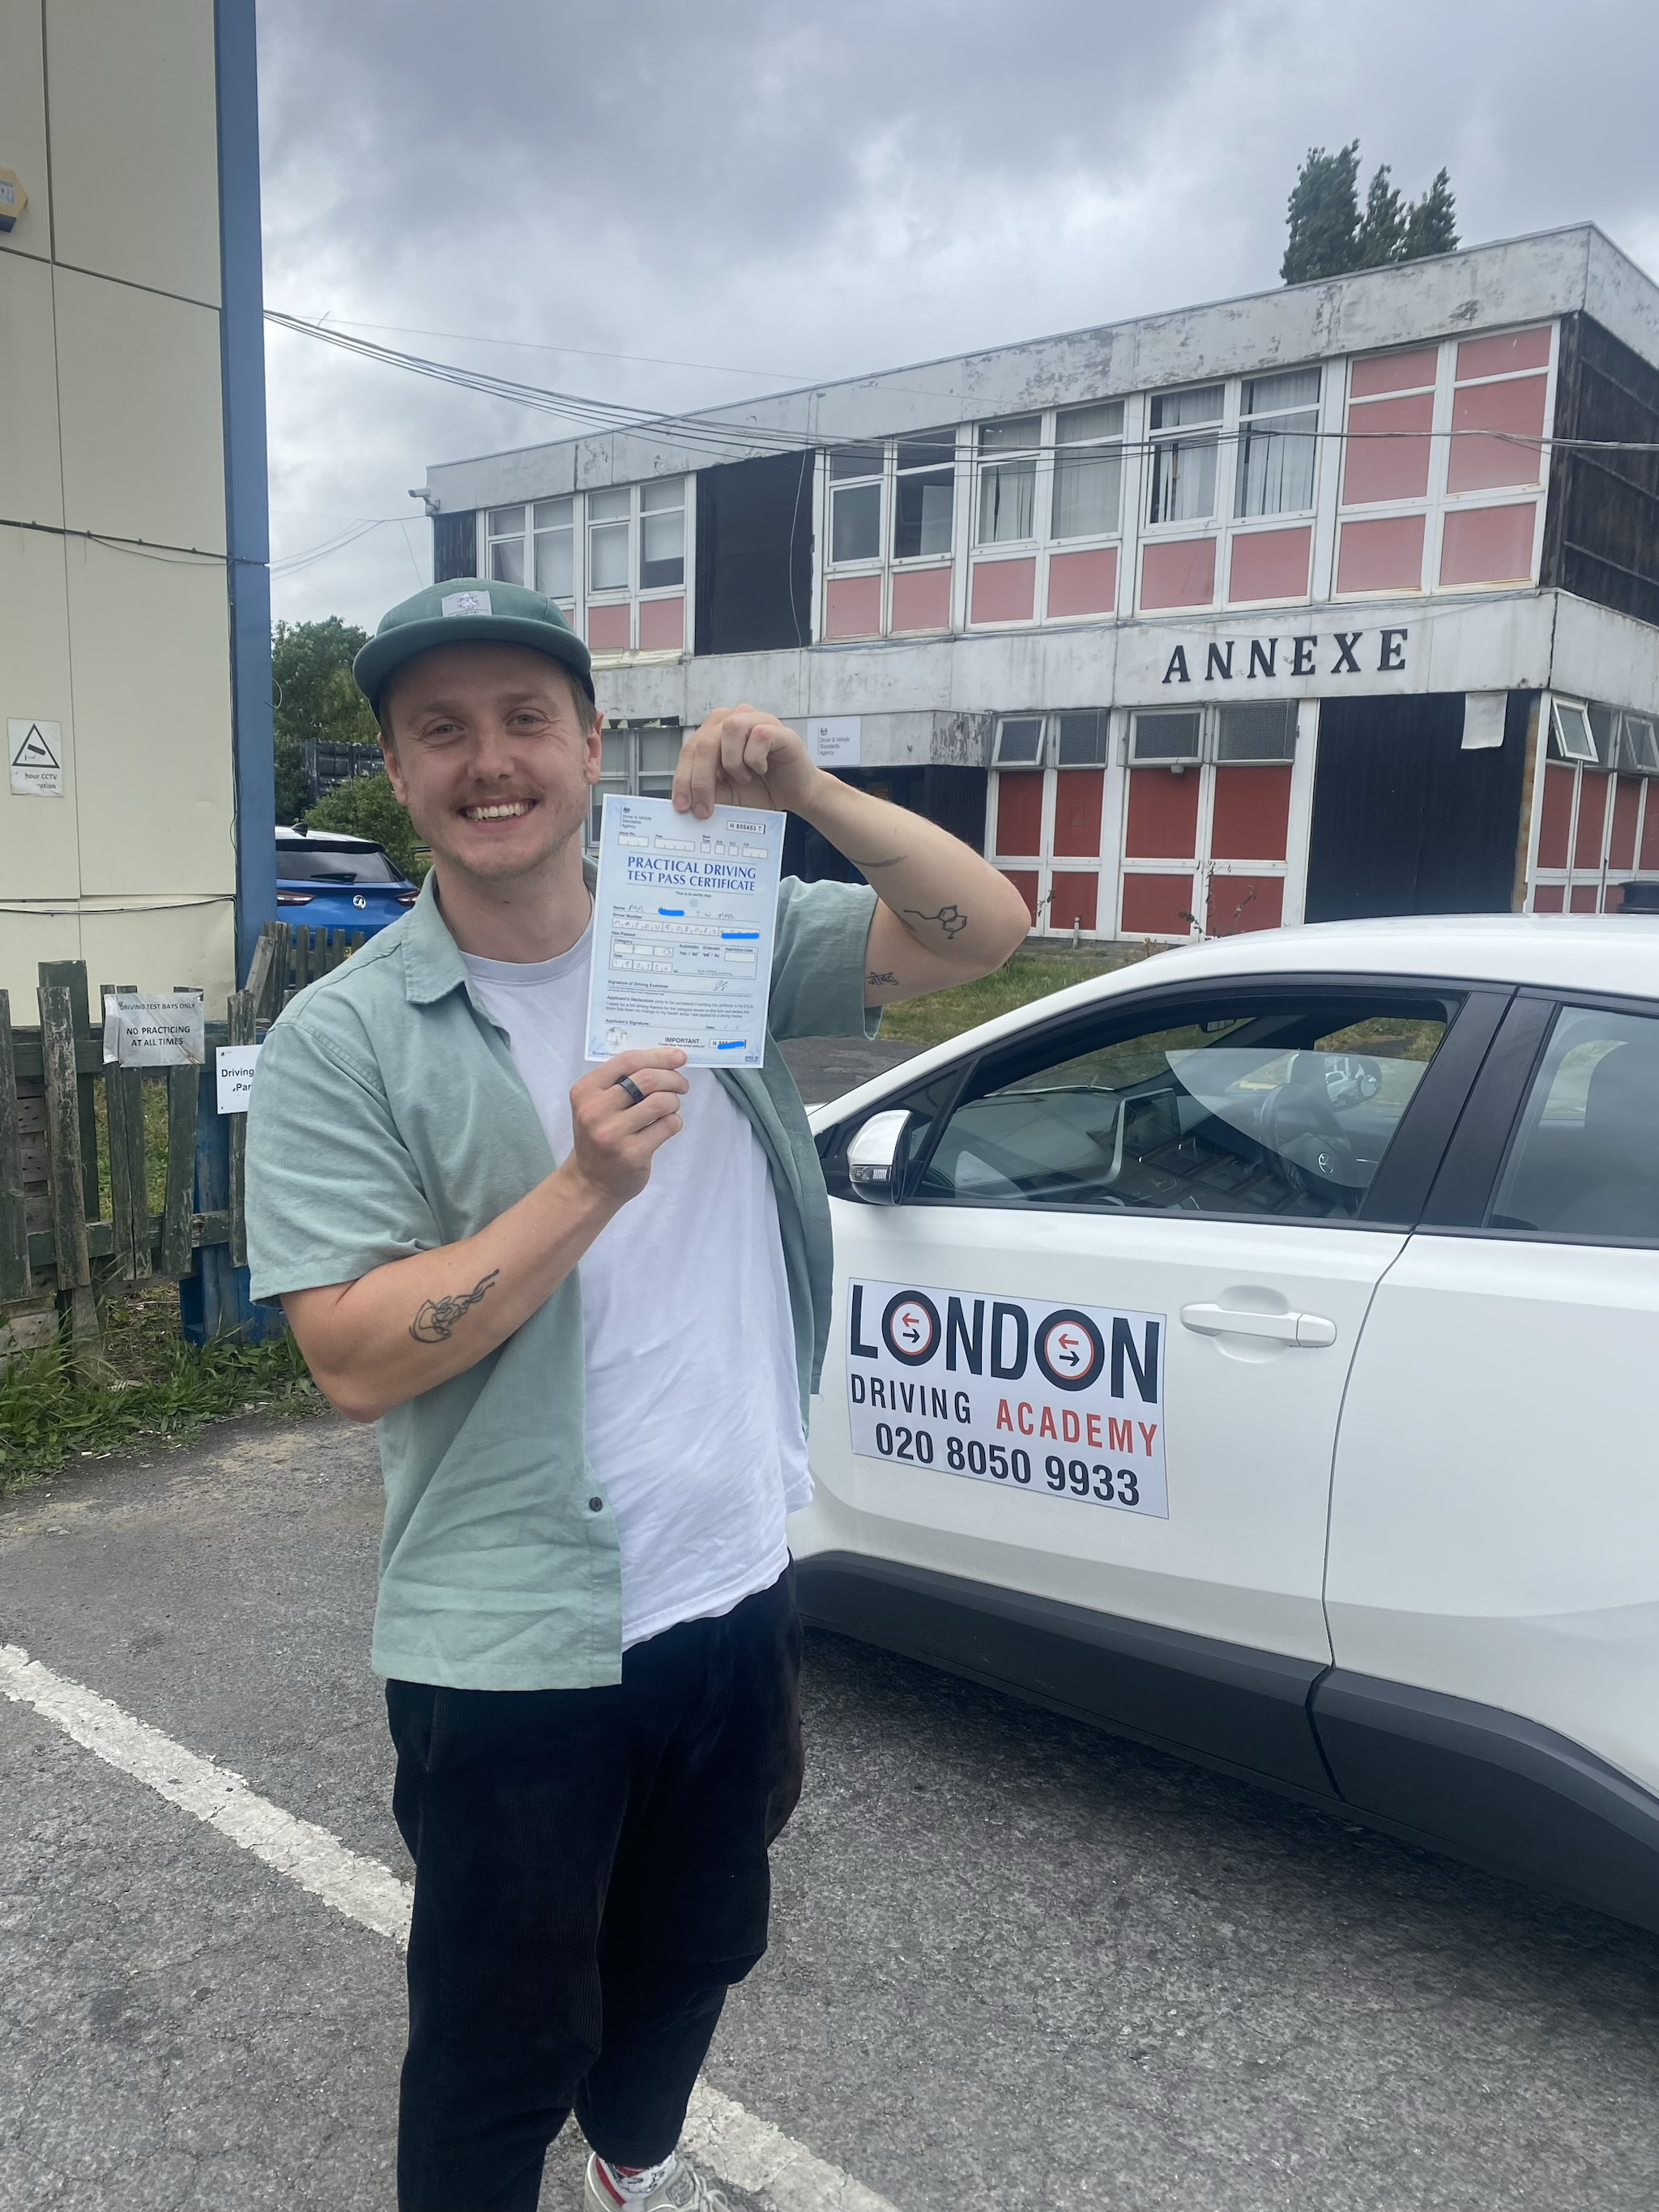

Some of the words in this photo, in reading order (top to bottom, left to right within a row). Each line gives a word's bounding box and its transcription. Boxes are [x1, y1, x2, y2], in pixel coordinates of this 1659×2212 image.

[1162, 628, 1409, 684] ANNEXE
[628, 856, 700, 874] PRACTICAL
[704, 863, 756, 879] DRIVING
[627, 870, 655, 882] TEST
[658, 872, 686, 885] PASS
[689, 876, 755, 891] CERTIFICATE
[142, 1026, 191, 1034] PRACTICING
[158, 1038, 183, 1046] TIMES
[221, 1068, 255, 1077] Driving
[850, 1284, 1159, 1404] LONDON
[851, 1374, 971, 1425] DRIVING
[996, 1398, 1158, 1458] ACADEMY
[876, 1422, 933, 1464] 020
[947, 1436, 1031, 1484] 8050
[1045, 1455, 1140, 1507] 9933
